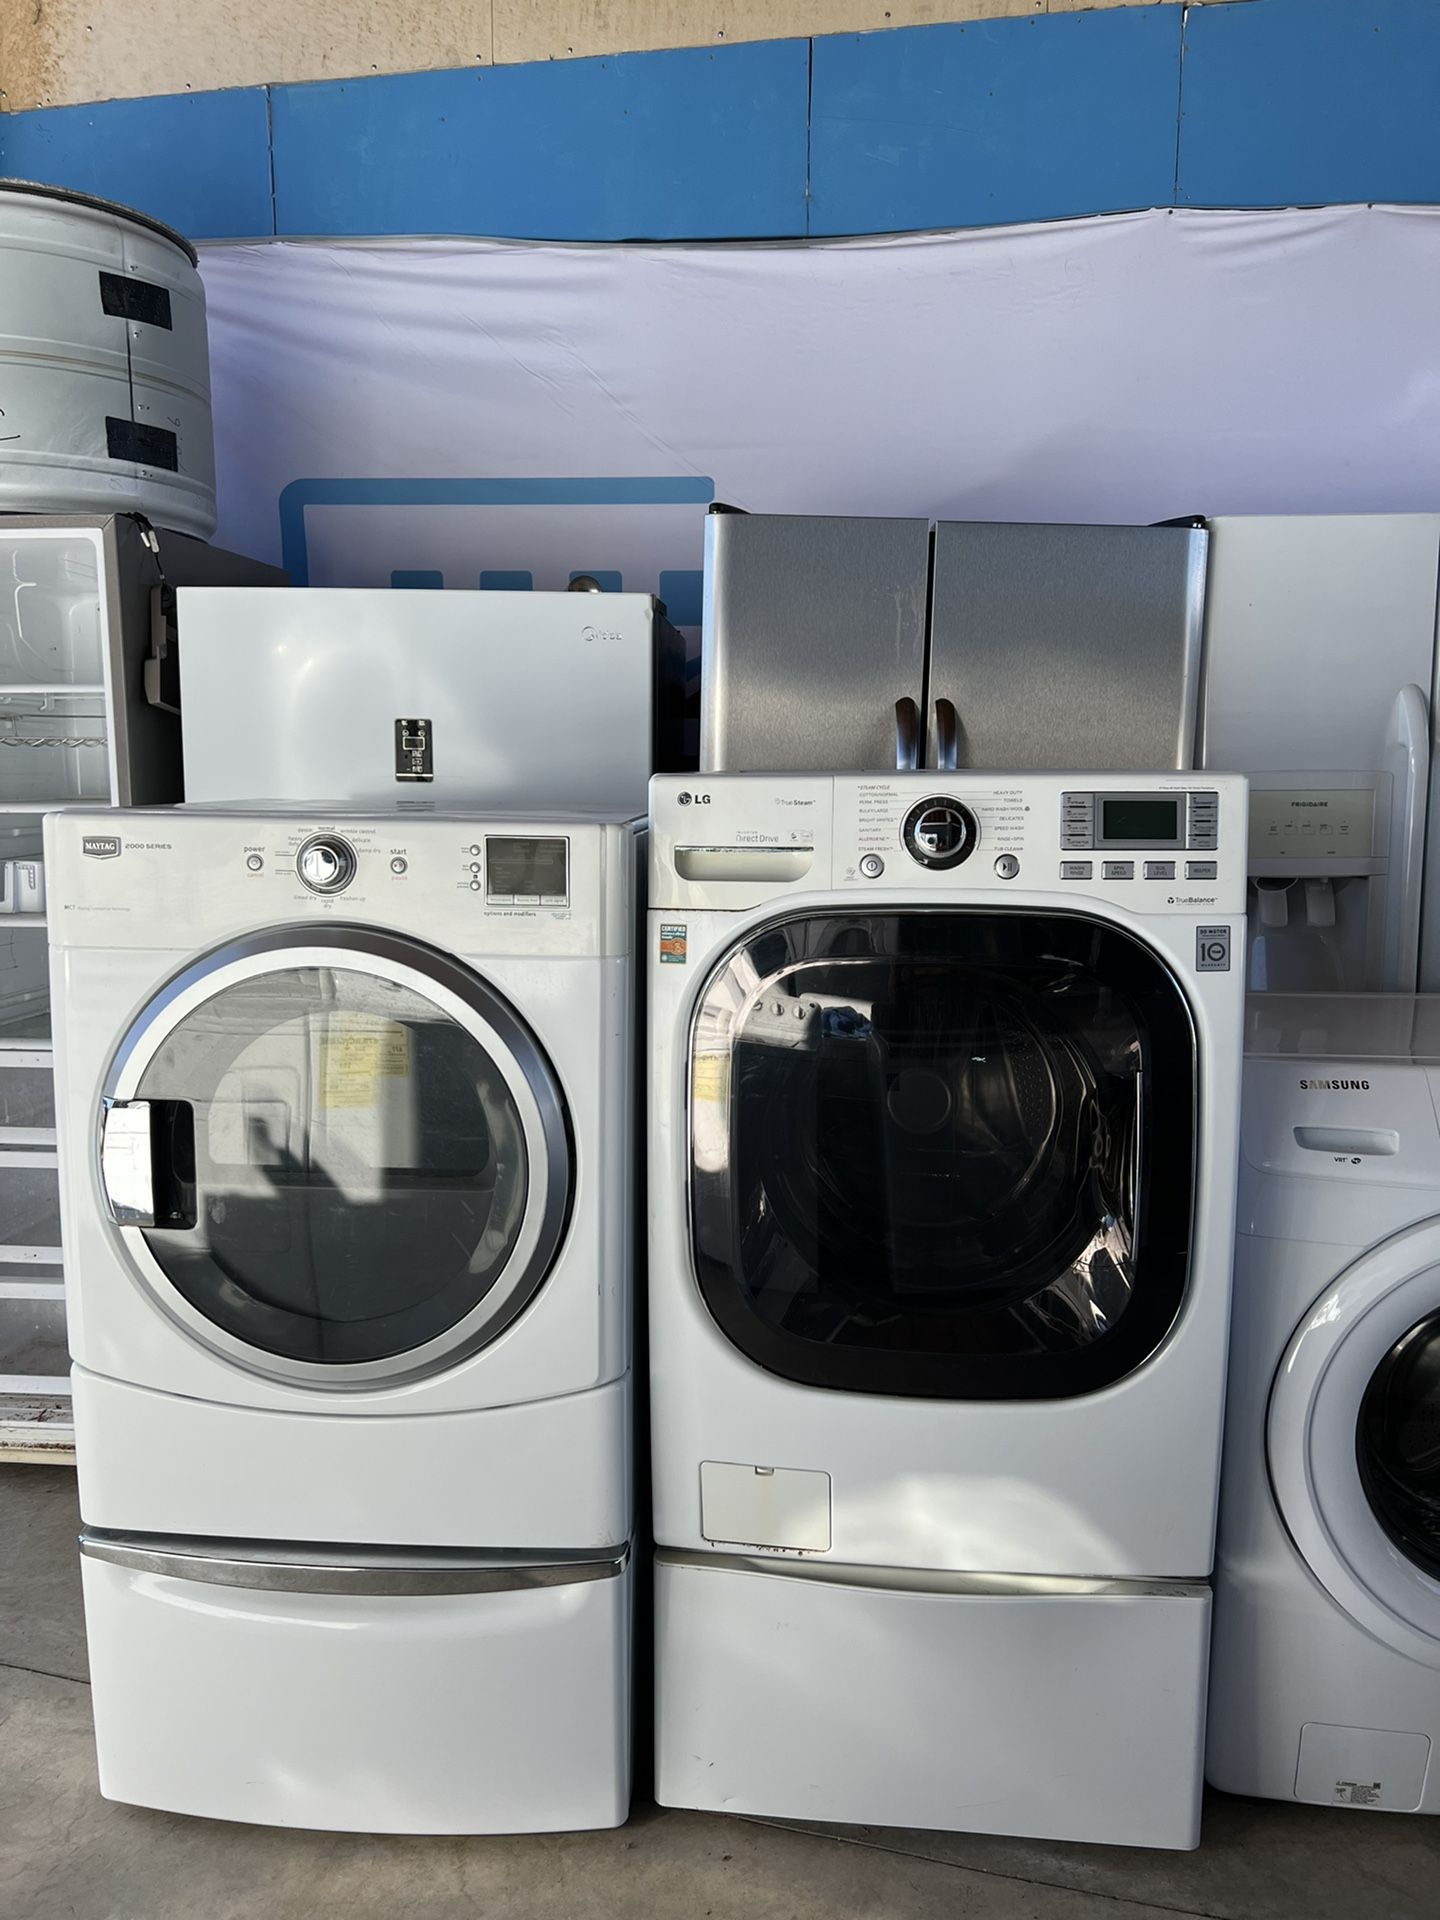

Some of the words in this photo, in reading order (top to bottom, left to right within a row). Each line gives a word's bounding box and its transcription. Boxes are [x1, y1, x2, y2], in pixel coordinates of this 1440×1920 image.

[694, 794, 711, 804] LG
[736, 834, 758, 842] Direct
[760, 834, 779, 842] Drive
[85, 842, 115, 850] MAYTAG
[1200, 942, 1226, 961] 10
[1300, 1080, 1370, 1090] SAMSUNG
